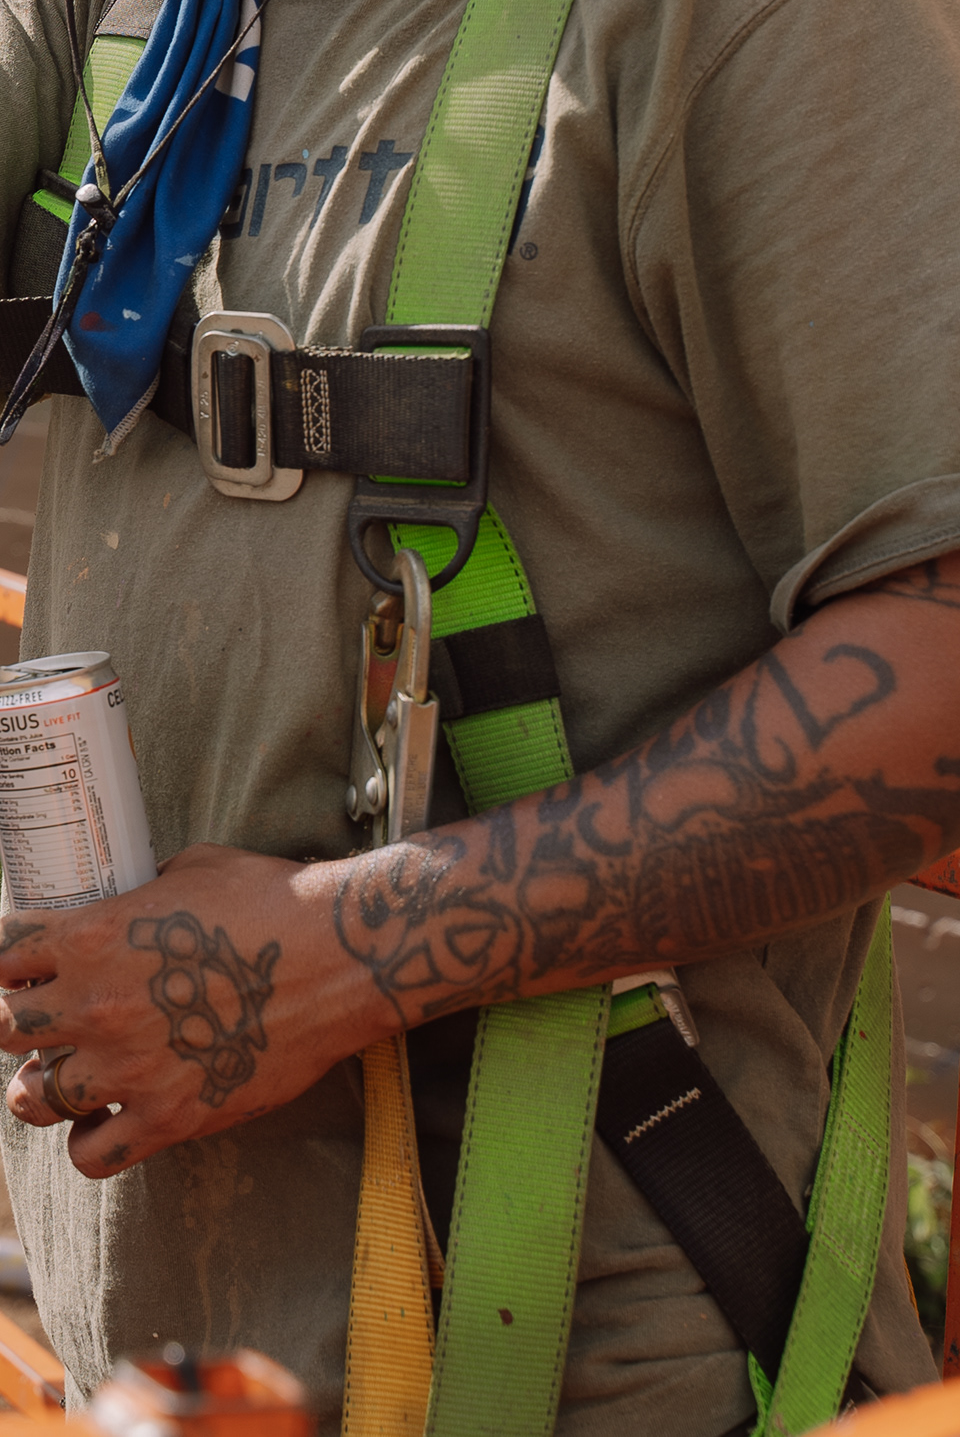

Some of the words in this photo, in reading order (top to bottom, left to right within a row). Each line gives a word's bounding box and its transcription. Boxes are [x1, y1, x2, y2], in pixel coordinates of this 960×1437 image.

[43, 716, 64, 727] LIVE
[67, 712, 80, 724] FIT
[24, 741, 56, 753] Facts
[61, 768, 77, 780] 10
